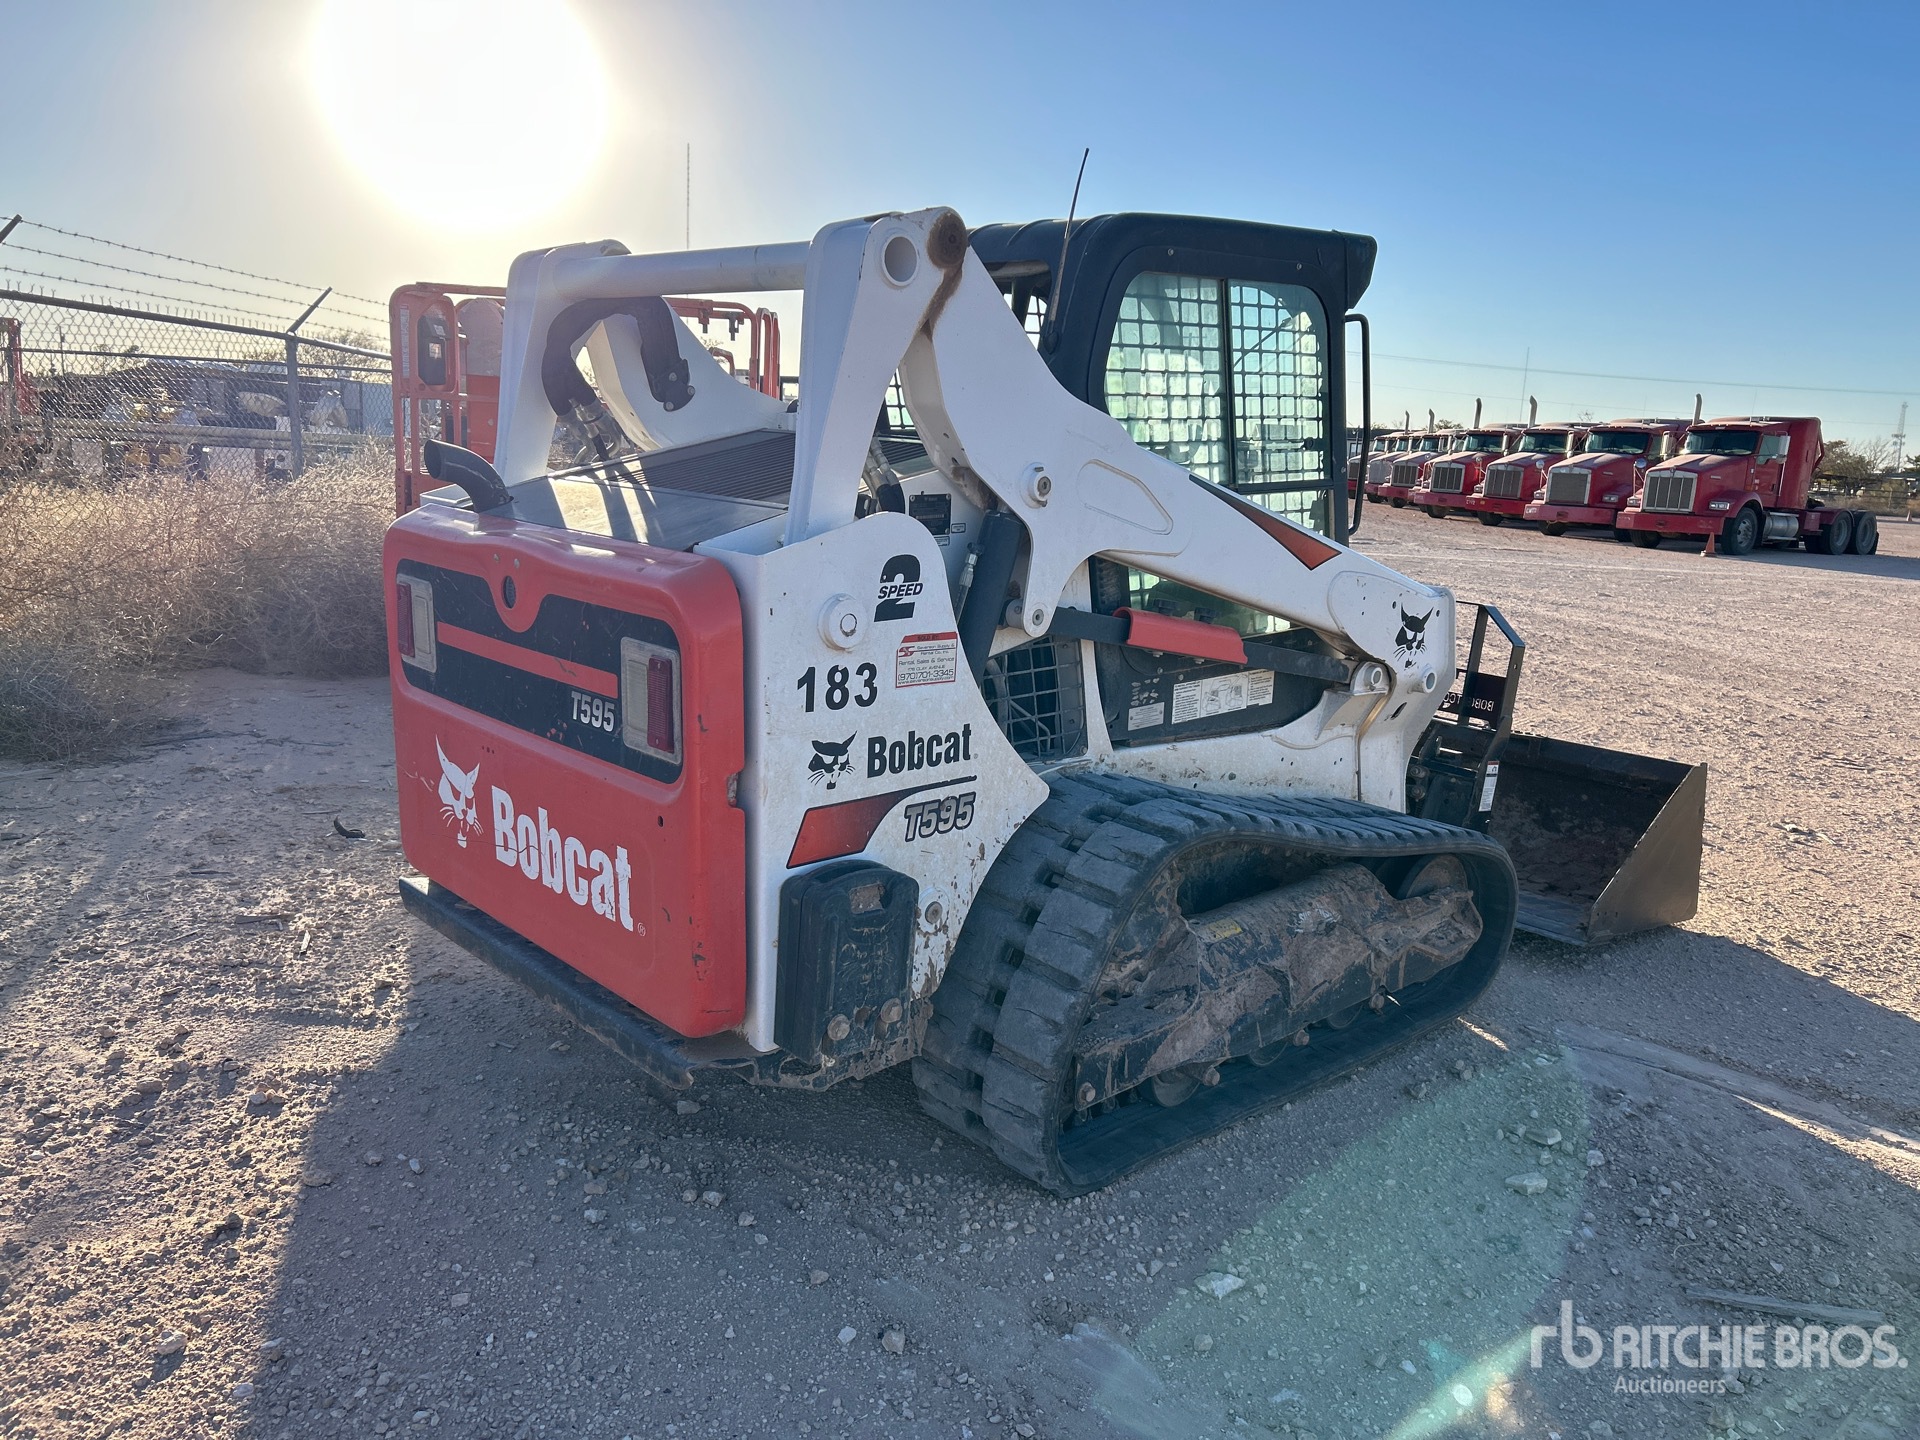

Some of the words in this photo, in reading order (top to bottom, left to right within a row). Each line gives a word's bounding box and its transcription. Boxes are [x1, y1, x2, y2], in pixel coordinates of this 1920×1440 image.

[874, 554, 921, 623] 2
[878, 583, 923, 599] SPEED
[571, 690, 616, 733] T595
[797, 662, 878, 713] 183
[867, 723, 972, 778] Bobcat
[904, 791, 976, 842] T595
[491, 784, 634, 932] Bobcat
